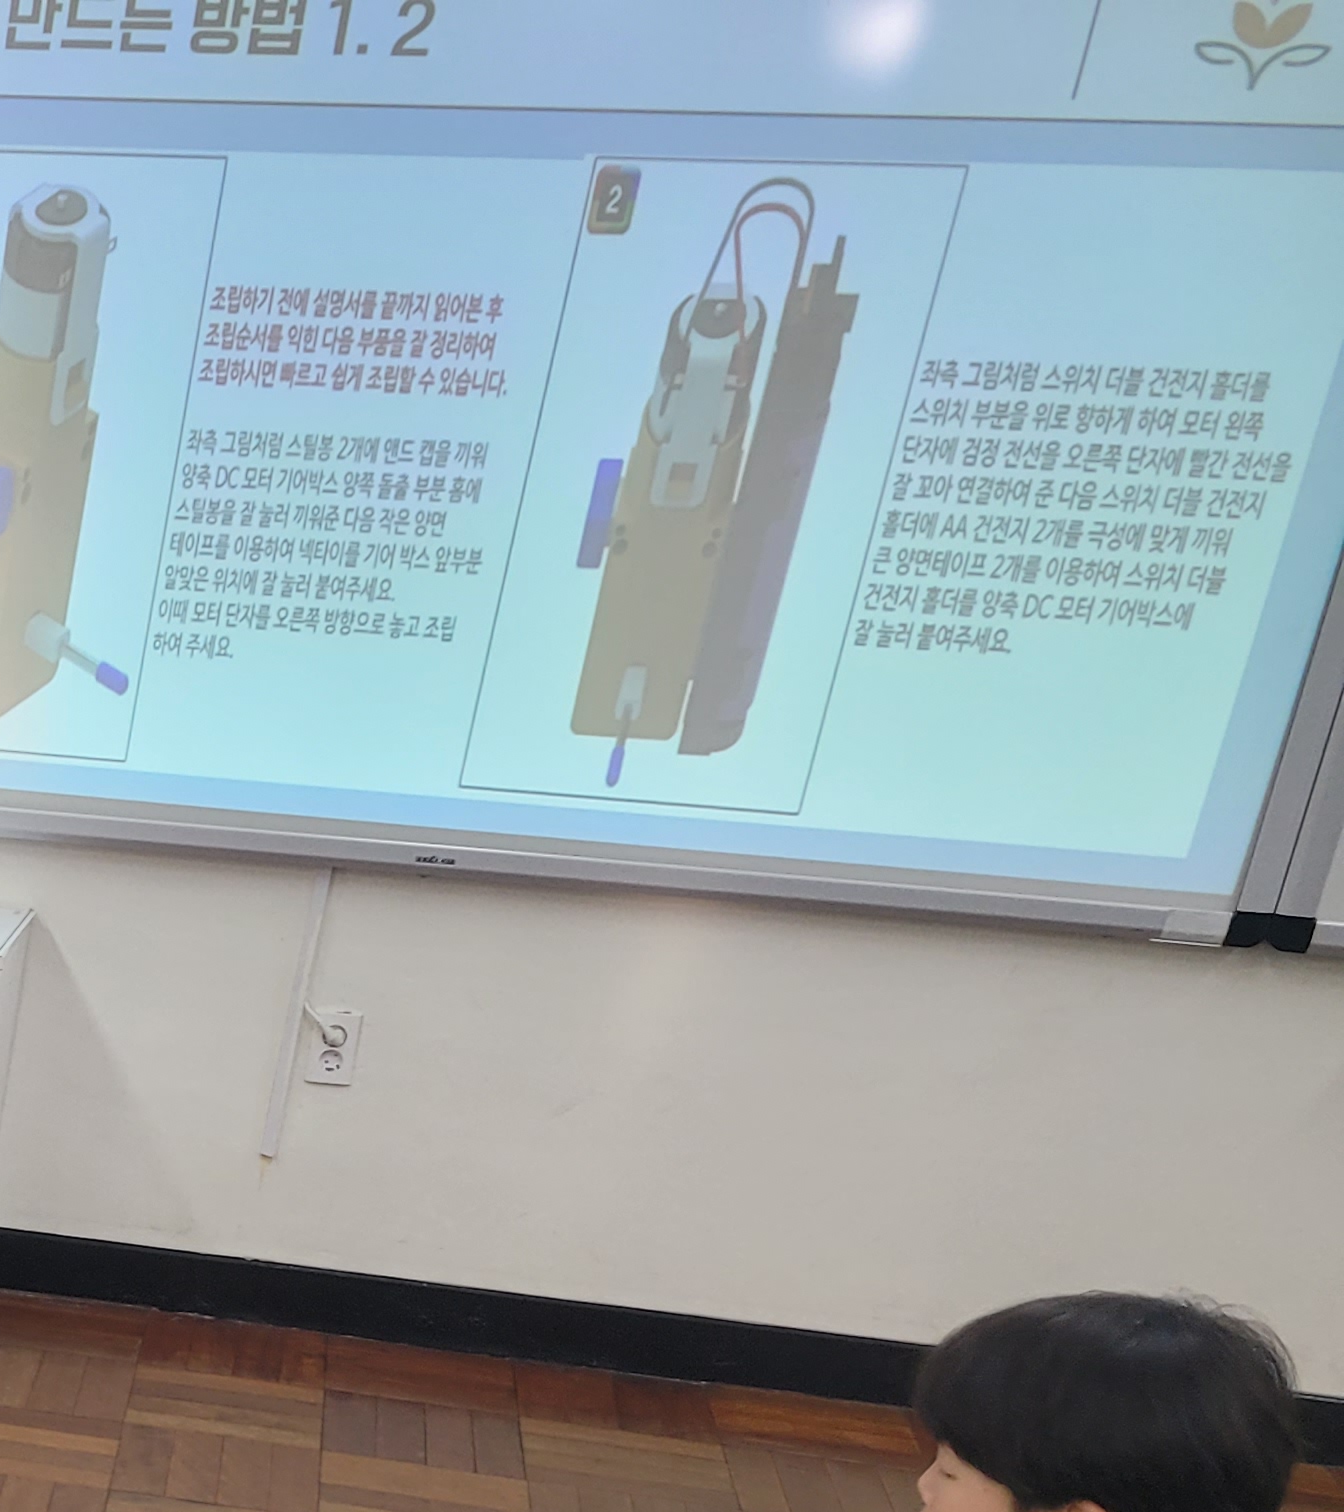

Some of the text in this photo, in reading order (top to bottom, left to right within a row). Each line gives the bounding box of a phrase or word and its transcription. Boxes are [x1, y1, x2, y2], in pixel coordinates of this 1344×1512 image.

[5, 0, 173, 53] 만드는
[189, 0, 306, 55] 방법
[390, 0, 436, 57] 2
[605, 184, 623, 214] 2
[209, 284, 504, 324] 조립하기 전에 설명서를 끝까지 읽어본 후
[203, 321, 497, 361] 조립순서를 익힌 다음 부품을 잘 정리하여
[197, 357, 278, 388] 조립하시면
[331, 361, 364, 392] 쉽게
[365, 364, 416, 394] 조립할
[418, 366, 435, 395] 수
[438, 367, 507, 398] 있습니다.
[919, 359, 1271, 402] 좌측 그림처럼 스위치 더블 건전지 홀더를
[909, 397, 1265, 442] 스위치 부분을 위로 향하게 하여 모터 왼쪽
[186, 428, 217, 456] 좌측
[220, 430, 284, 459] 그림처럼
[285, 433, 334, 462] 스틸봉
[336, 436, 381, 464] 2개에
[419, 439, 452, 468] 캡을
[453, 441, 489, 469] 끼워
[902, 434, 1292, 483] 단자에 검정 전선을 오른쪽 단자에 빨간 전선을
[215, 465, 241, 489] DC
[241, 466, 274, 493] 모터
[276, 467, 338, 496] 기어박스
[343, 471, 374, 498] 양쪽
[377, 472, 410, 500] 돌출
[413, 474, 447, 502] 부분
[892, 472, 913, 501] 잘
[912, 474, 953, 503] 꼬아
[956, 475, 1033, 507] 연결하여
[1058, 480, 1098, 511] 다음
[1099, 484, 1161, 514] 스위치
[1163, 486, 1203, 517] 더블
[1207, 488, 1268, 520] 건전지
[173, 498, 237, 526] 스틸봉을
[240, 500, 256, 527] 잘
[259, 501, 291, 529] 눌러
[343, 506, 375, 533] 다음
[379, 507, 410, 535] 작은
[414, 509, 447, 538] 양면
[881, 509, 1234, 558] 홀더에 AA 건전지 2개를 극성에 맞게 끼워
[169, 531, 230, 560] 테이프를
[234, 534, 296, 563] 이용하여
[434, 546, 483, 575] 앞부분
[872, 545, 892, 574] 큰
[989, 553, 1042, 584] 2개를
[1045, 555, 1123, 588] 이용하여
[1123, 561, 1185, 592] 스위치
[1187, 565, 1227, 596] 더블
[164, 564, 209, 592] 알맞은
[212, 567, 259, 595] 위치에
[261, 570, 278, 597] 잘
[280, 571, 313, 599] 눌러
[190, 600, 223, 627] 모터
[225, 602, 271, 631] 단자를
[272, 606, 320, 634] 오른쪽
[324, 608, 386, 636] 방향으로
[388, 612, 420, 639] 놓고
[423, 615, 457, 643] 조립
[864, 583, 919, 613] 건전지
[921, 586, 979, 617] 홀더를
[1022, 593, 1054, 620] DC
[1054, 595, 1096, 624] 모터
[1097, 597, 1196, 631] 기어박스에
[153, 632, 183, 658] 하여
[853, 619, 874, 646] 잘
[876, 620, 915, 649] 눌러
